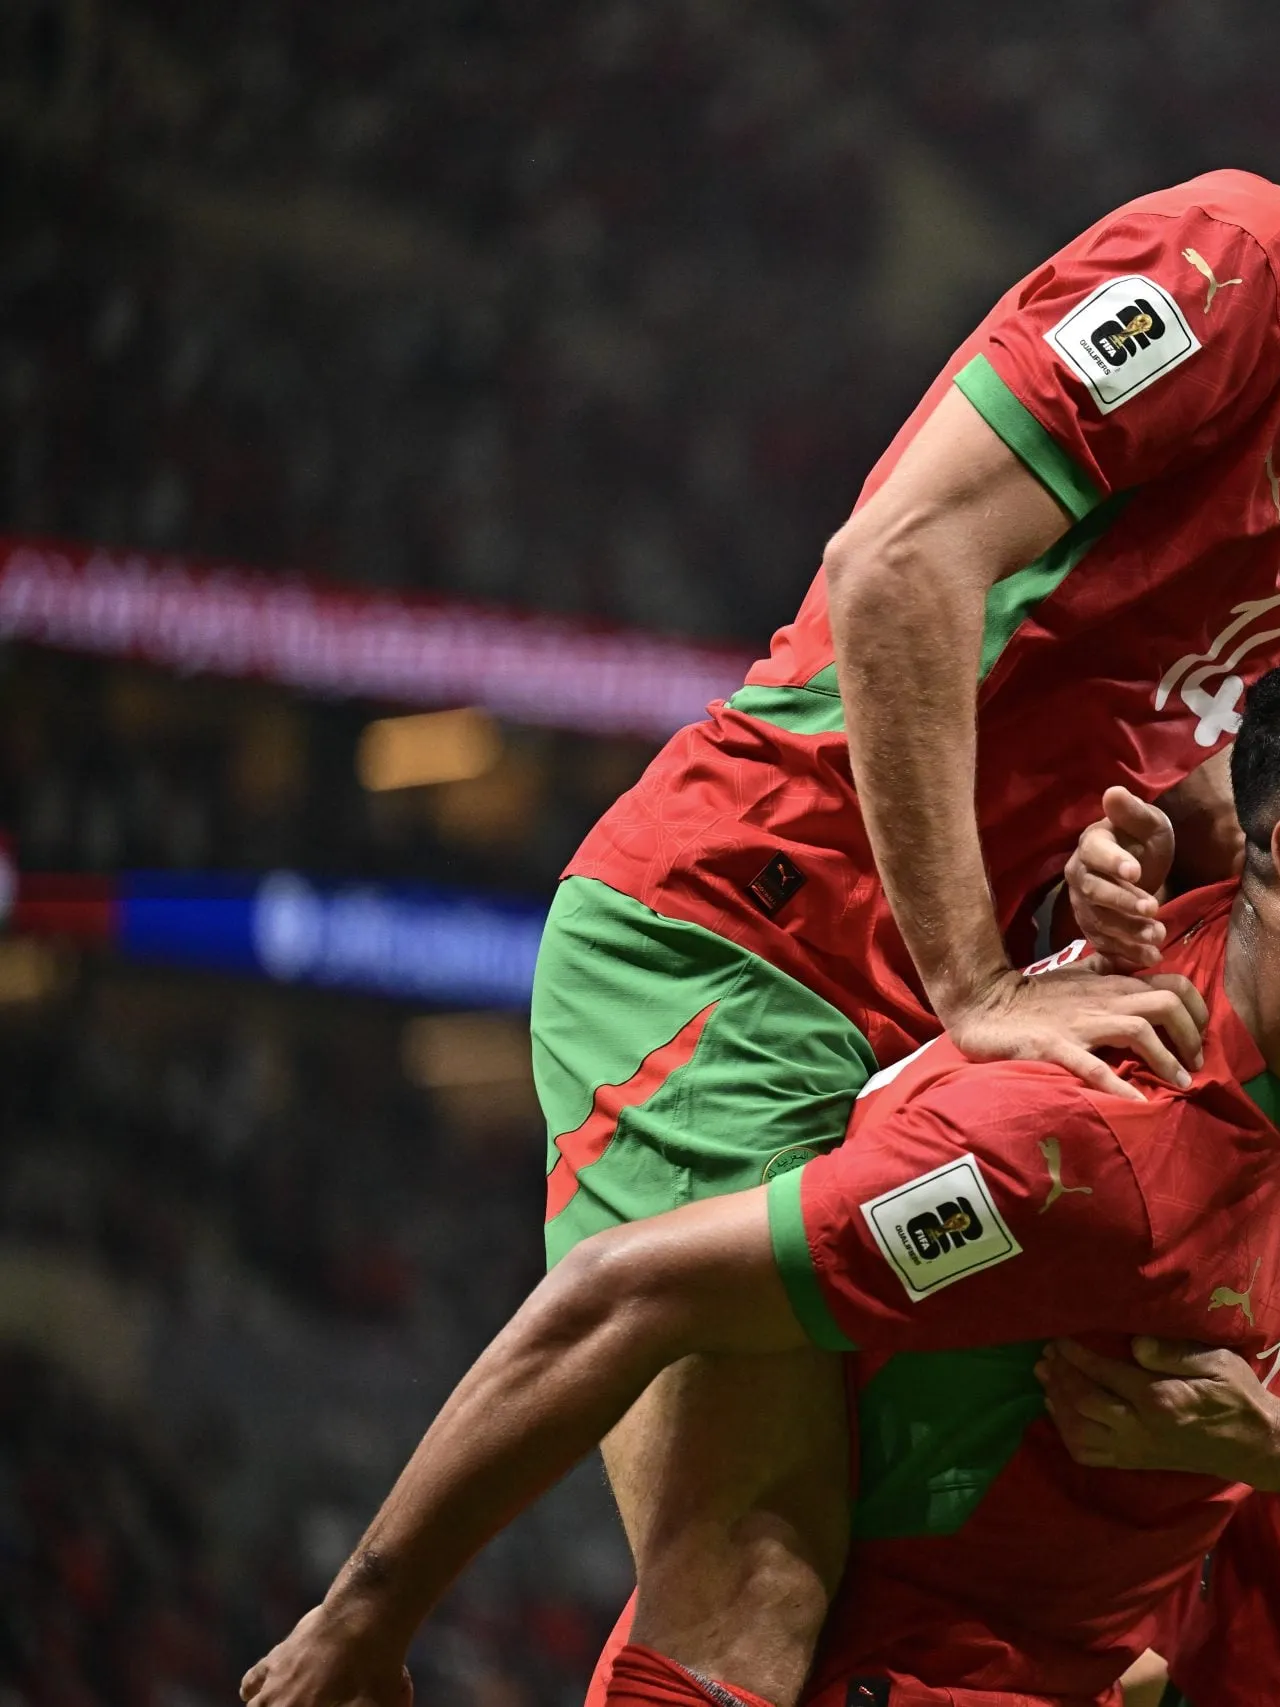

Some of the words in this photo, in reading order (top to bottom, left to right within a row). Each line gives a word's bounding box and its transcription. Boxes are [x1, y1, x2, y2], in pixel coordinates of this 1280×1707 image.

[1079, 339, 1111, 376] QUALIFIERS
[1099, 338, 1117, 358] FIFA
[914, 1229, 931, 1251] FIFA
